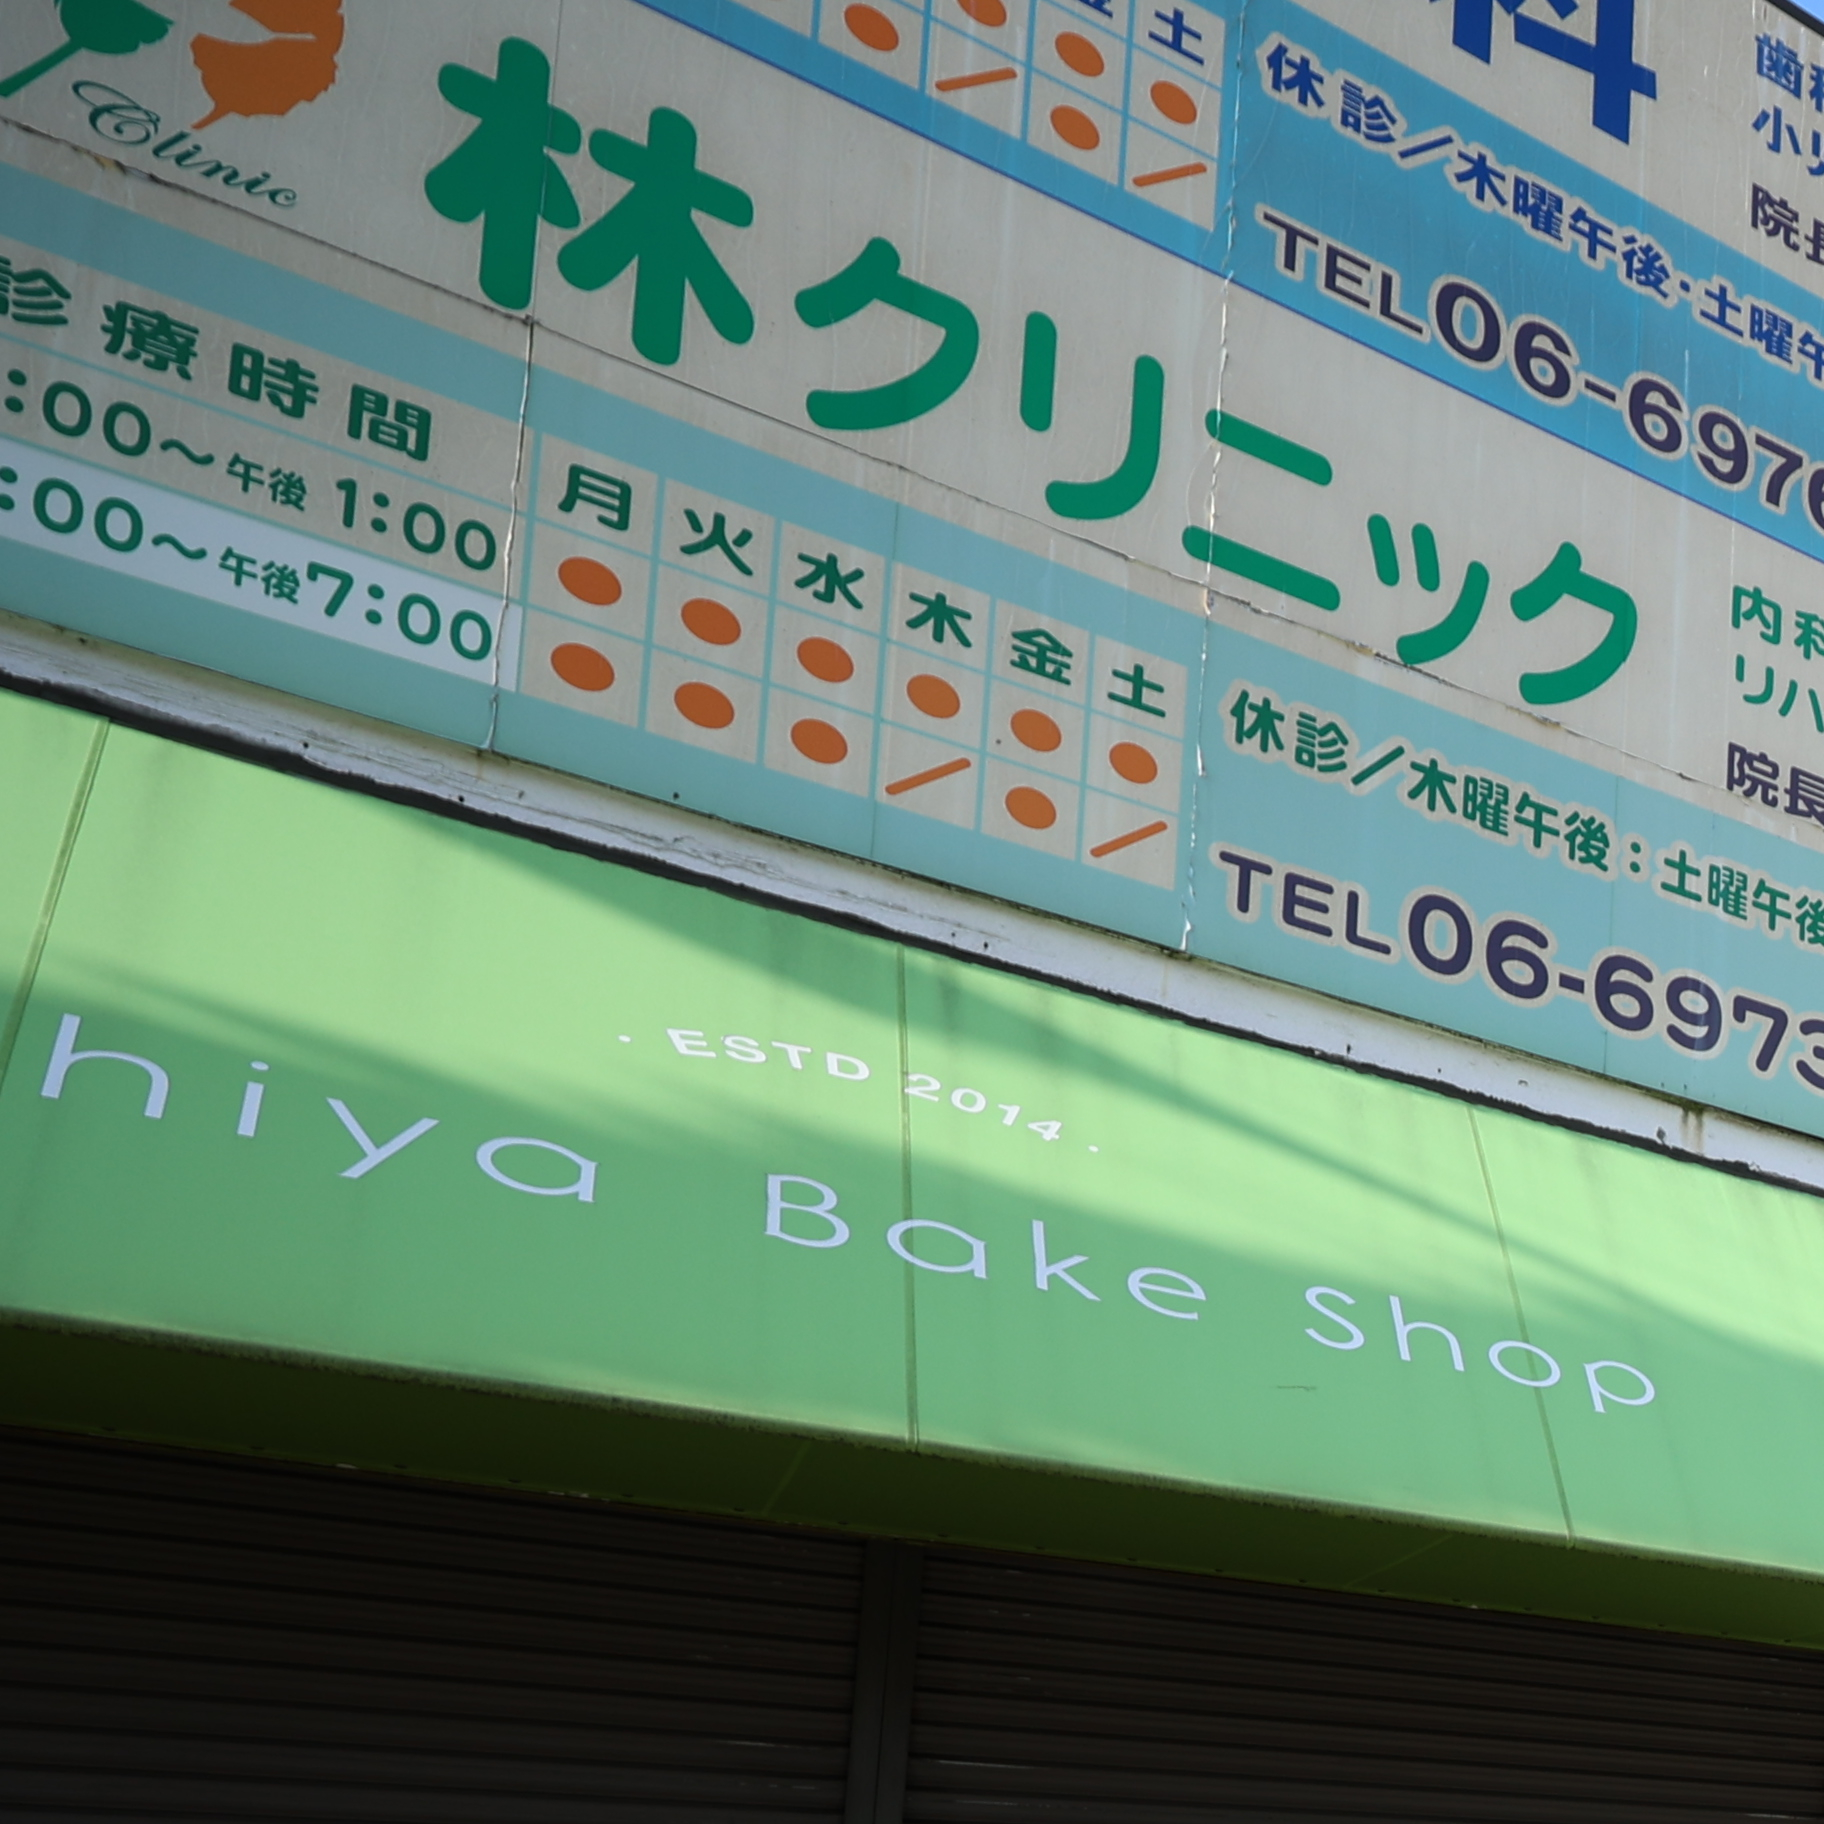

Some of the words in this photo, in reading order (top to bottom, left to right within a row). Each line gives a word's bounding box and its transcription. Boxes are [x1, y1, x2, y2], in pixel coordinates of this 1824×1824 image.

[1148, 7, 1205, 66] 土
[72, 80, 298, 208] Clinic
[0, 255, 433, 461] 診療時間
[424, 36, 1638, 705] 林クリニック
[557, 463, 632, 531] 月
[679, 507, 754, 577] 火
[794, 552, 864, 610] 水
[906, 590, 972, 648] 木
[1010, 627, 1072, 686] 金
[1107, 663, 1167, 718] 土
[666, 1027, 872, 1082] ESTD
[903, 1073, 1064, 1143] 2014
[40, 1012, 598, 1203] hiya
[764, 1172, 1207, 1321] Bake
[1303, 1284, 1657, 1414] Shop
